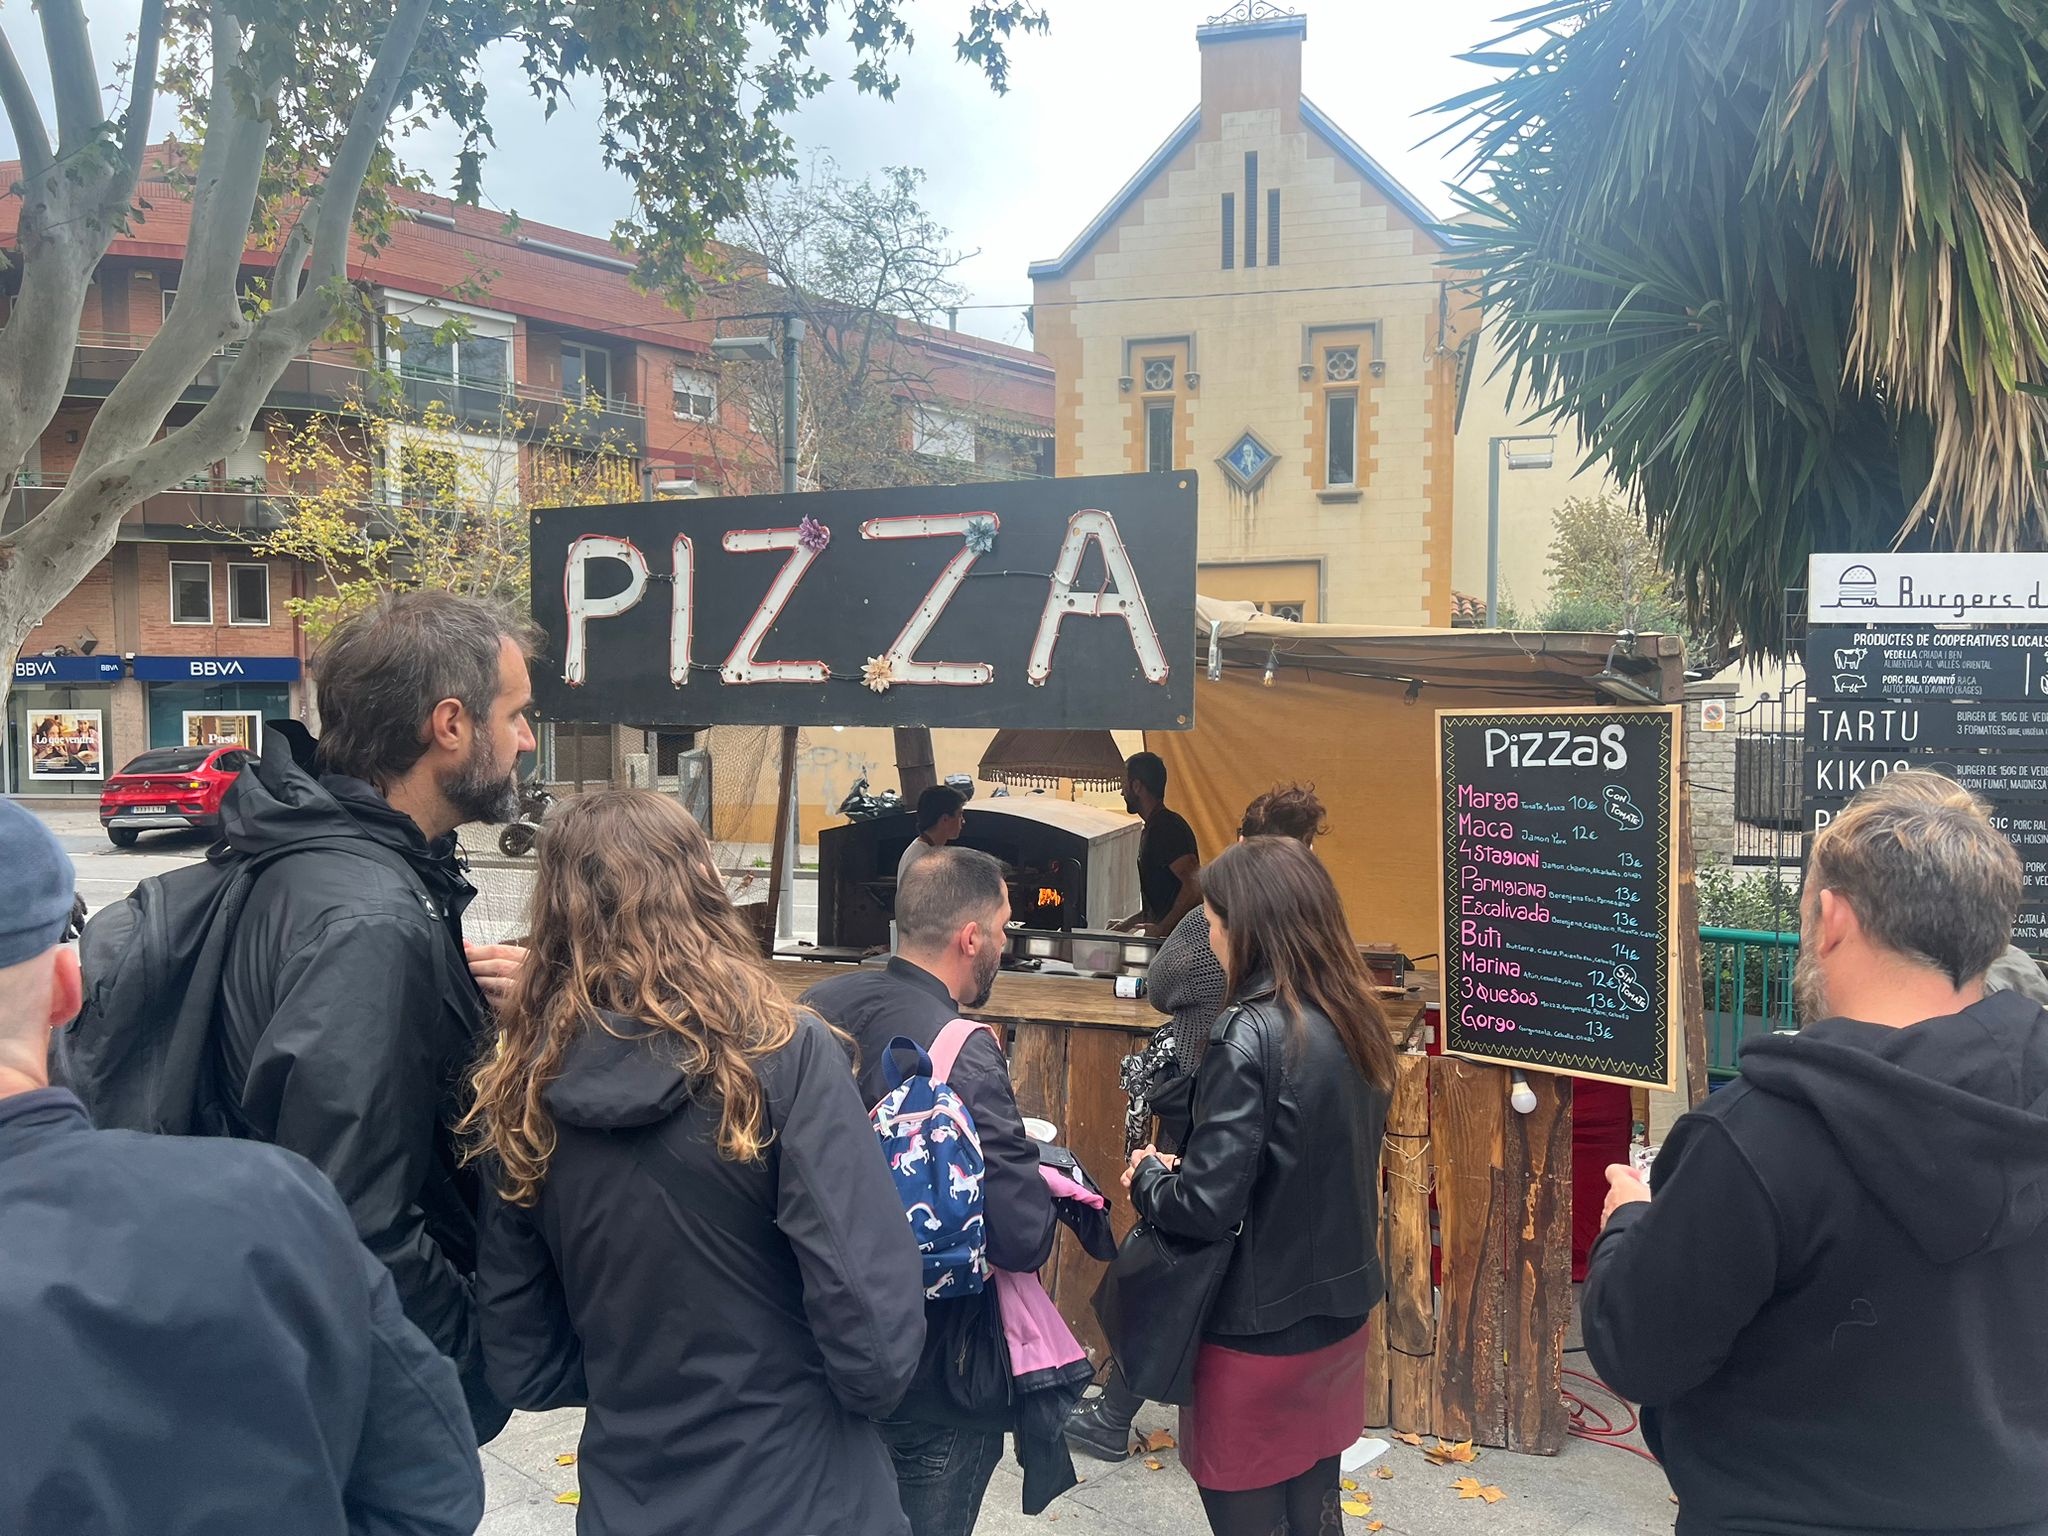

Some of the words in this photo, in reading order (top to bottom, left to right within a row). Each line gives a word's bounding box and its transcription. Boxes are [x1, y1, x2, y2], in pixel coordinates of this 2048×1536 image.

[562, 508, 1168, 687] PIZZA
[1900, 576, 2012, 617] Burgers
[1853, 633, 1914, 646] PRODUCTES
[1916, 634, 1930, 646] DE
[1933, 634, 2009, 647] COOPERATIVES
[1884, 650, 1918, 659] VEDELLA
[1919, 650, 1942, 659] CRIADA
[1948, 651, 1962, 659] BEN
[16, 661, 56, 677] BBVA
[101, 664, 119, 672] BBVA
[190, 661, 244, 676] BBVA
[1884, 660, 1923, 668] ALIMENTADA
[1925, 660, 1933, 668] AL
[1962, 661, 1992, 669] ORIENTAL
[1882, 675, 1903, 684] PORC
[1905, 675, 1919, 684] RAL
[1922, 674, 1955, 684] D'AVINYÓ
[1955, 685, 1982, 695] (BAGES)
[1957, 711, 1986, 721] BURGER
[1988, 712, 1997, 721] DE
[2001, 712, 2017, 721] 150G
[2020, 712, 2028, 721] DE
[1818, 710, 1918, 741] TARTU
[1957, 725, 1962, 734] 3
[1964, 725, 2006, 735] FORMATGES
[36, 735, 48, 744] Lo
[208, 734, 238, 744] Paso
[1957, 765, 1986, 775] BURGER
[1987, 766, 1997, 775] DE
[2000, 766, 2016, 775] 150G
[2019, 766, 2028, 776] DE
[1983, 780, 2009, 790] FUMAT,
[2010, 780, 2047, 790] MAIONESA
[1458, 784, 1519, 811] Marga
[1568, 795, 1598, 811] 10€
[1611, 803, 1640, 826] TOMATE
[1459, 813, 1513, 840] Maca
[1572, 825, 1599, 840] 12€
[2013, 820, 2032, 830] PORC
[2024, 834, 2048, 844] HOISIN
[1459, 839, 1472, 861] 4
[1618, 852, 1644, 868] 13€
[2026, 862, 2047, 872] PORK
[1461, 865, 1547, 899] Parmigiana
[1615, 886, 1641, 903] 13€
[2023, 875, 2033, 886] DE
[1461, 895, 1550, 923] Escalivada
[1613, 911, 1639, 927] 13€
[2018, 913, 2046, 924] CATALÀ
[1461, 920, 1501, 949] Buti
[1611, 942, 1640, 961] 14€
[1462, 950, 1521, 978] Marina
[1587, 970, 1619, 989] 12€
[1616, 967, 1634, 984] SIN
[1460, 976, 1474, 999] 3
[1586, 993, 1616, 1009] 13€
[1621, 982, 1646, 1008] TOMATE
[1461, 1004, 1516, 1033] Gorgo
[1585, 1021, 1614, 1039] 13€
